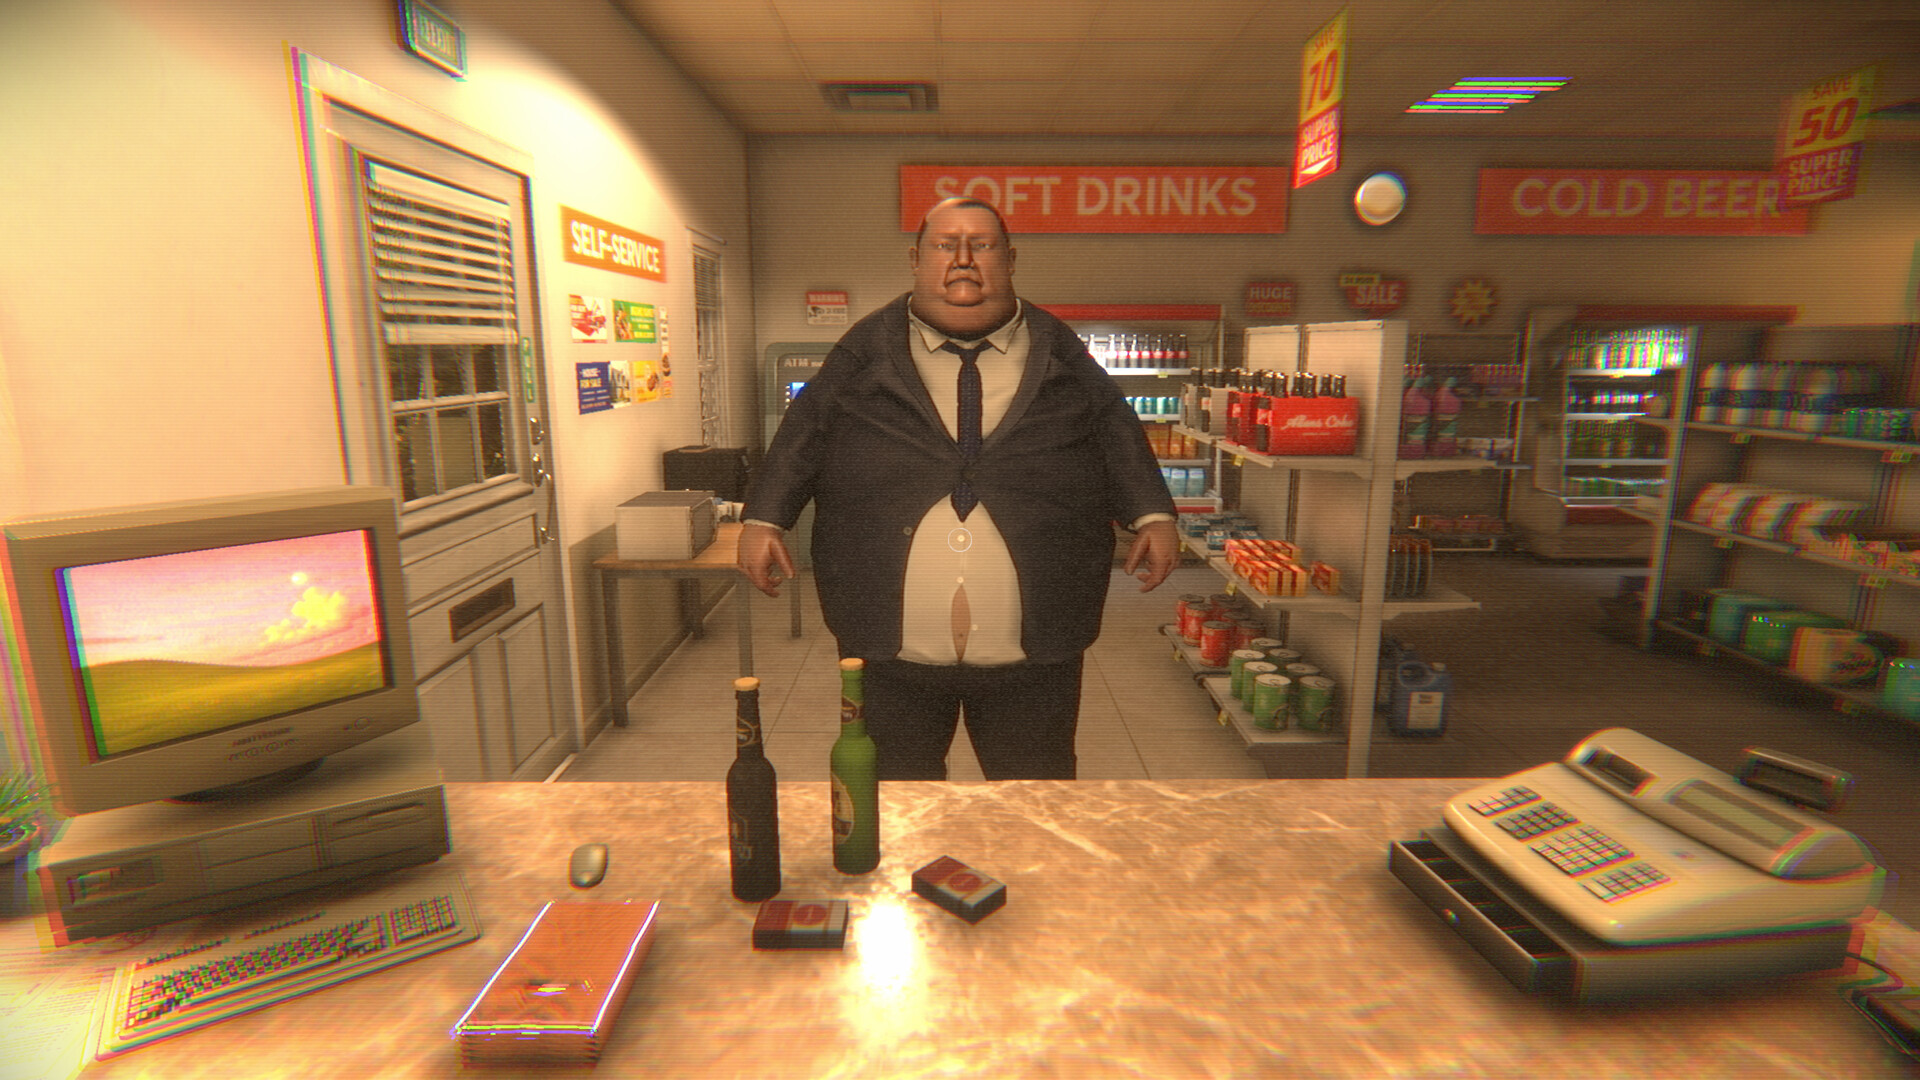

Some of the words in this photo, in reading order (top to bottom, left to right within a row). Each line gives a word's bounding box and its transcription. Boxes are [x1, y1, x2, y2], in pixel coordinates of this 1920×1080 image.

[1314, 22, 1336, 53] SAVE
[1307, 49, 1338, 111] 70
[1812, 75, 1853, 101] SAVE
[1302, 109, 1338, 143] SUPER
[1792, 97, 1859, 148] 50
[1301, 132, 1336, 169] PRICE
[1788, 148, 1854, 179] SUPER
[933, 175, 1062, 216] SOFT
[1076, 175, 1258, 216] DRINKS
[1786, 168, 1849, 196] PRICE
[1512, 178, 1650, 218] COLD
[1663, 178, 1783, 218] BEER
[571, 219, 661, 274] SELF-SERVICE
[1249, 286, 1292, 300] HUGE
[1355, 284, 1400, 305] SALE
[783, 358, 809, 368] ATM
[591, 377, 602, 388] SALE
